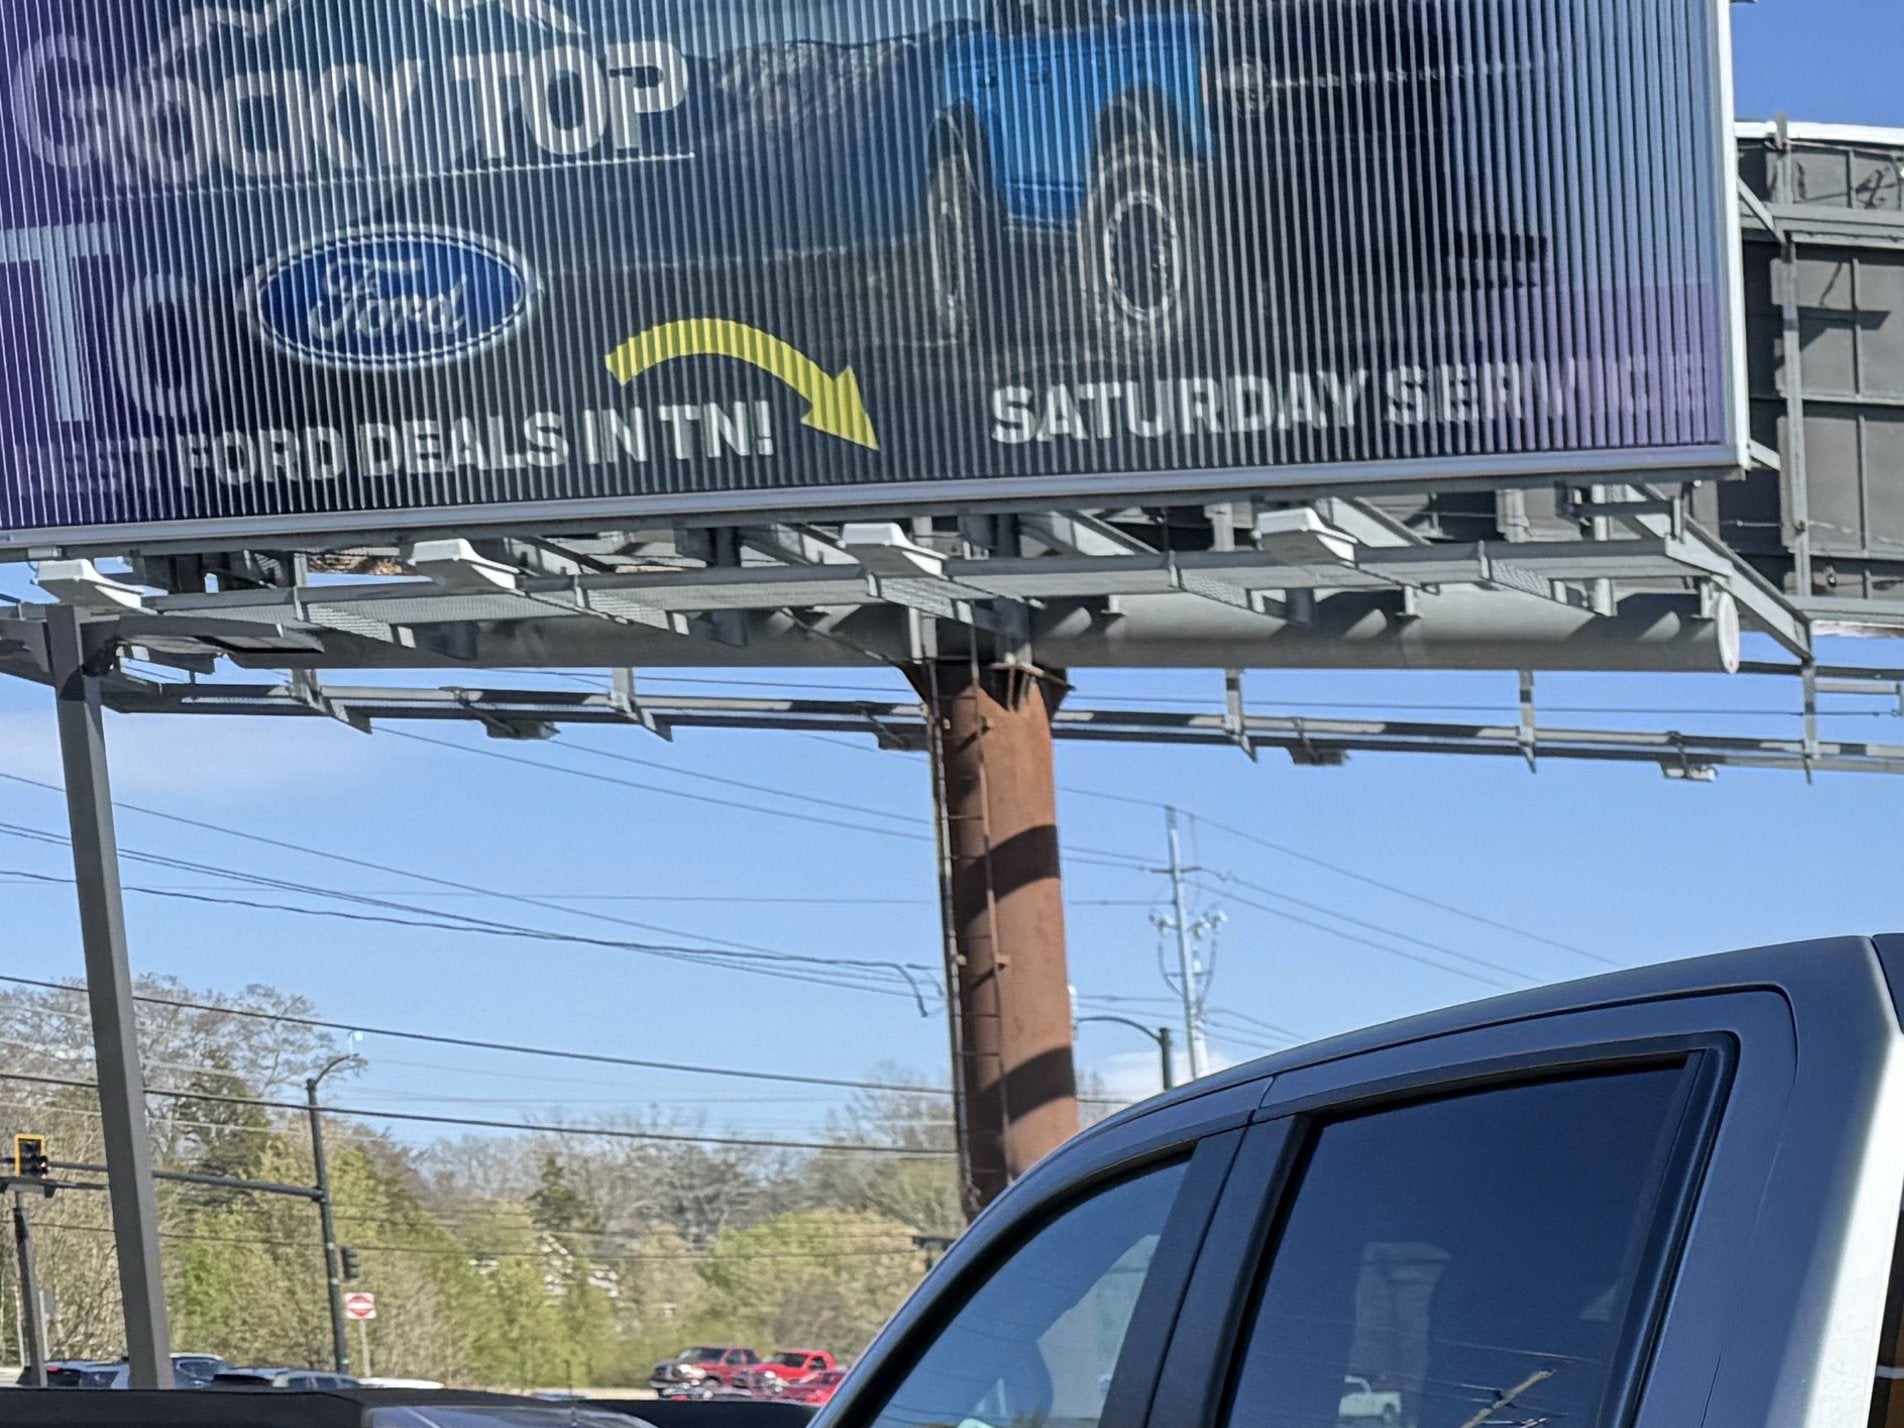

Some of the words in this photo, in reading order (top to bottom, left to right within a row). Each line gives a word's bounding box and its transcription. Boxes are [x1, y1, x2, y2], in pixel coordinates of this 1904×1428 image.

[450, 40, 689, 160] TOP
[309, 256, 468, 341] Ford
[176, 425, 347, 488] FORD
[357, 409, 570, 480] DEALS
[583, 406, 648, 465] IN
[658, 399, 774, 460] TN!
[990, 368, 1367, 445] SATURDAY
